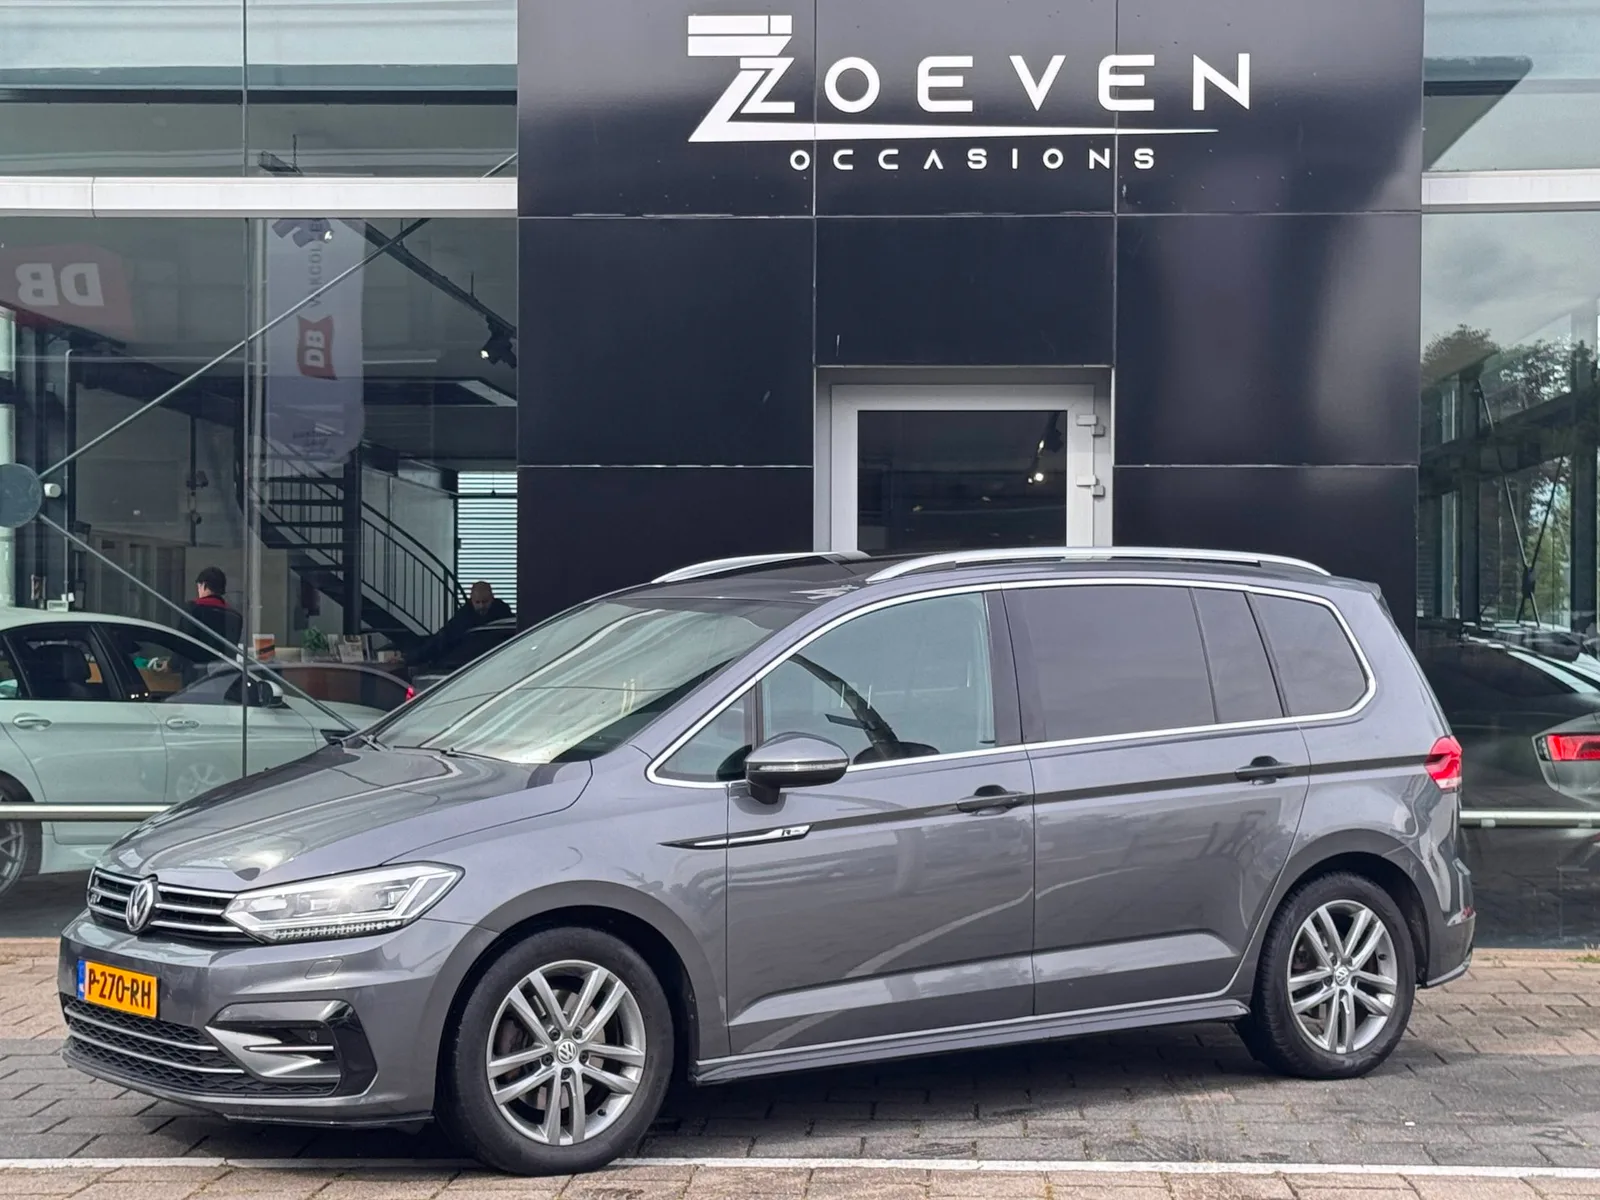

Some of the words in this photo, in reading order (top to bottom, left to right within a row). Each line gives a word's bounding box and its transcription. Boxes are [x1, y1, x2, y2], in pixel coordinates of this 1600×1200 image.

[688, 15, 1250, 114] ZOEVEN
[790, 148, 1155, 171] OCCASIONS
[304, 329, 325, 368] DB
[87, 967, 152, 1009] P-270-RH
